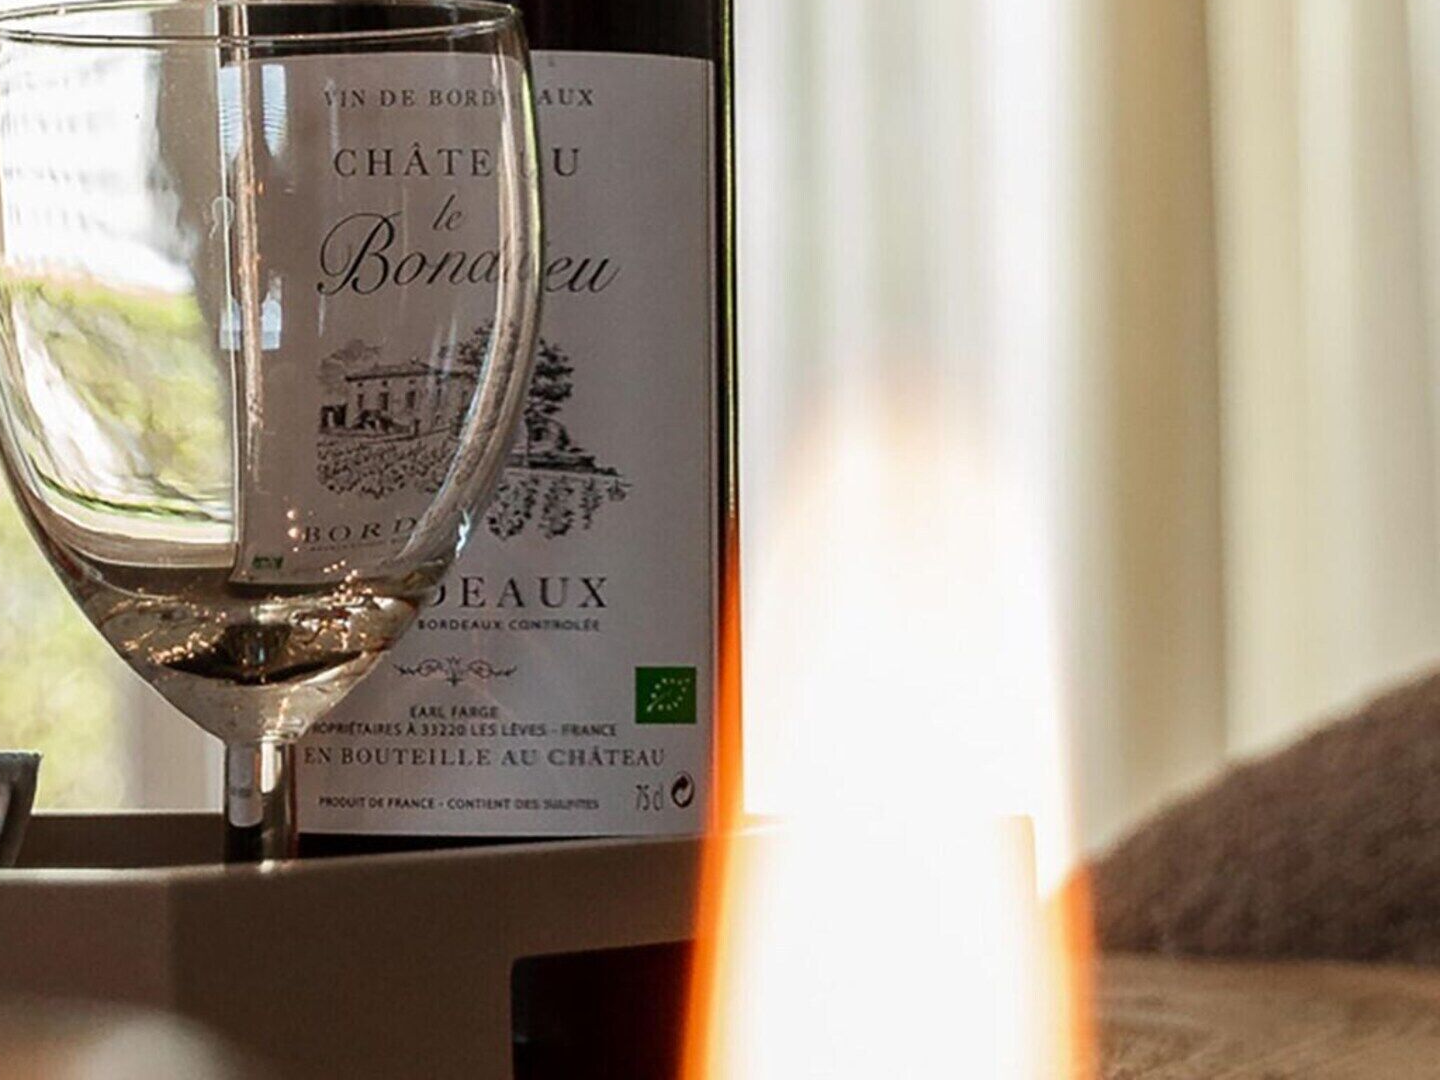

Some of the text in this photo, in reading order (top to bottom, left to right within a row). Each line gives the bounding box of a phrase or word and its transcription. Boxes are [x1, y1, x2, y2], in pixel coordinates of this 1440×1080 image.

[380, 89, 415, 107] DE
[429, 89, 594, 107] BORDAUX
[334, 142, 579, 177] CHÂTEU
[432, 194, 462, 231] le
[418, 619, 501, 631] BORDEAUX
[410, 706, 498, 718] EARL FARGE
[421, 724, 467, 737] 33220
[471, 724, 496, 737] LES
[561, 723, 616, 737] FRANCE
[304, 748, 331, 765] EN
[341, 748, 491, 766] BOUTEILLE
[501, 749, 538, 766] AU
[318, 796, 365, 809] PRODUIT
[368, 797, 384, 809] DE
[387, 797, 434, 810] FRANCE
[447, 798, 511, 810] CONTIENT
[515, 798, 540, 810] DES
